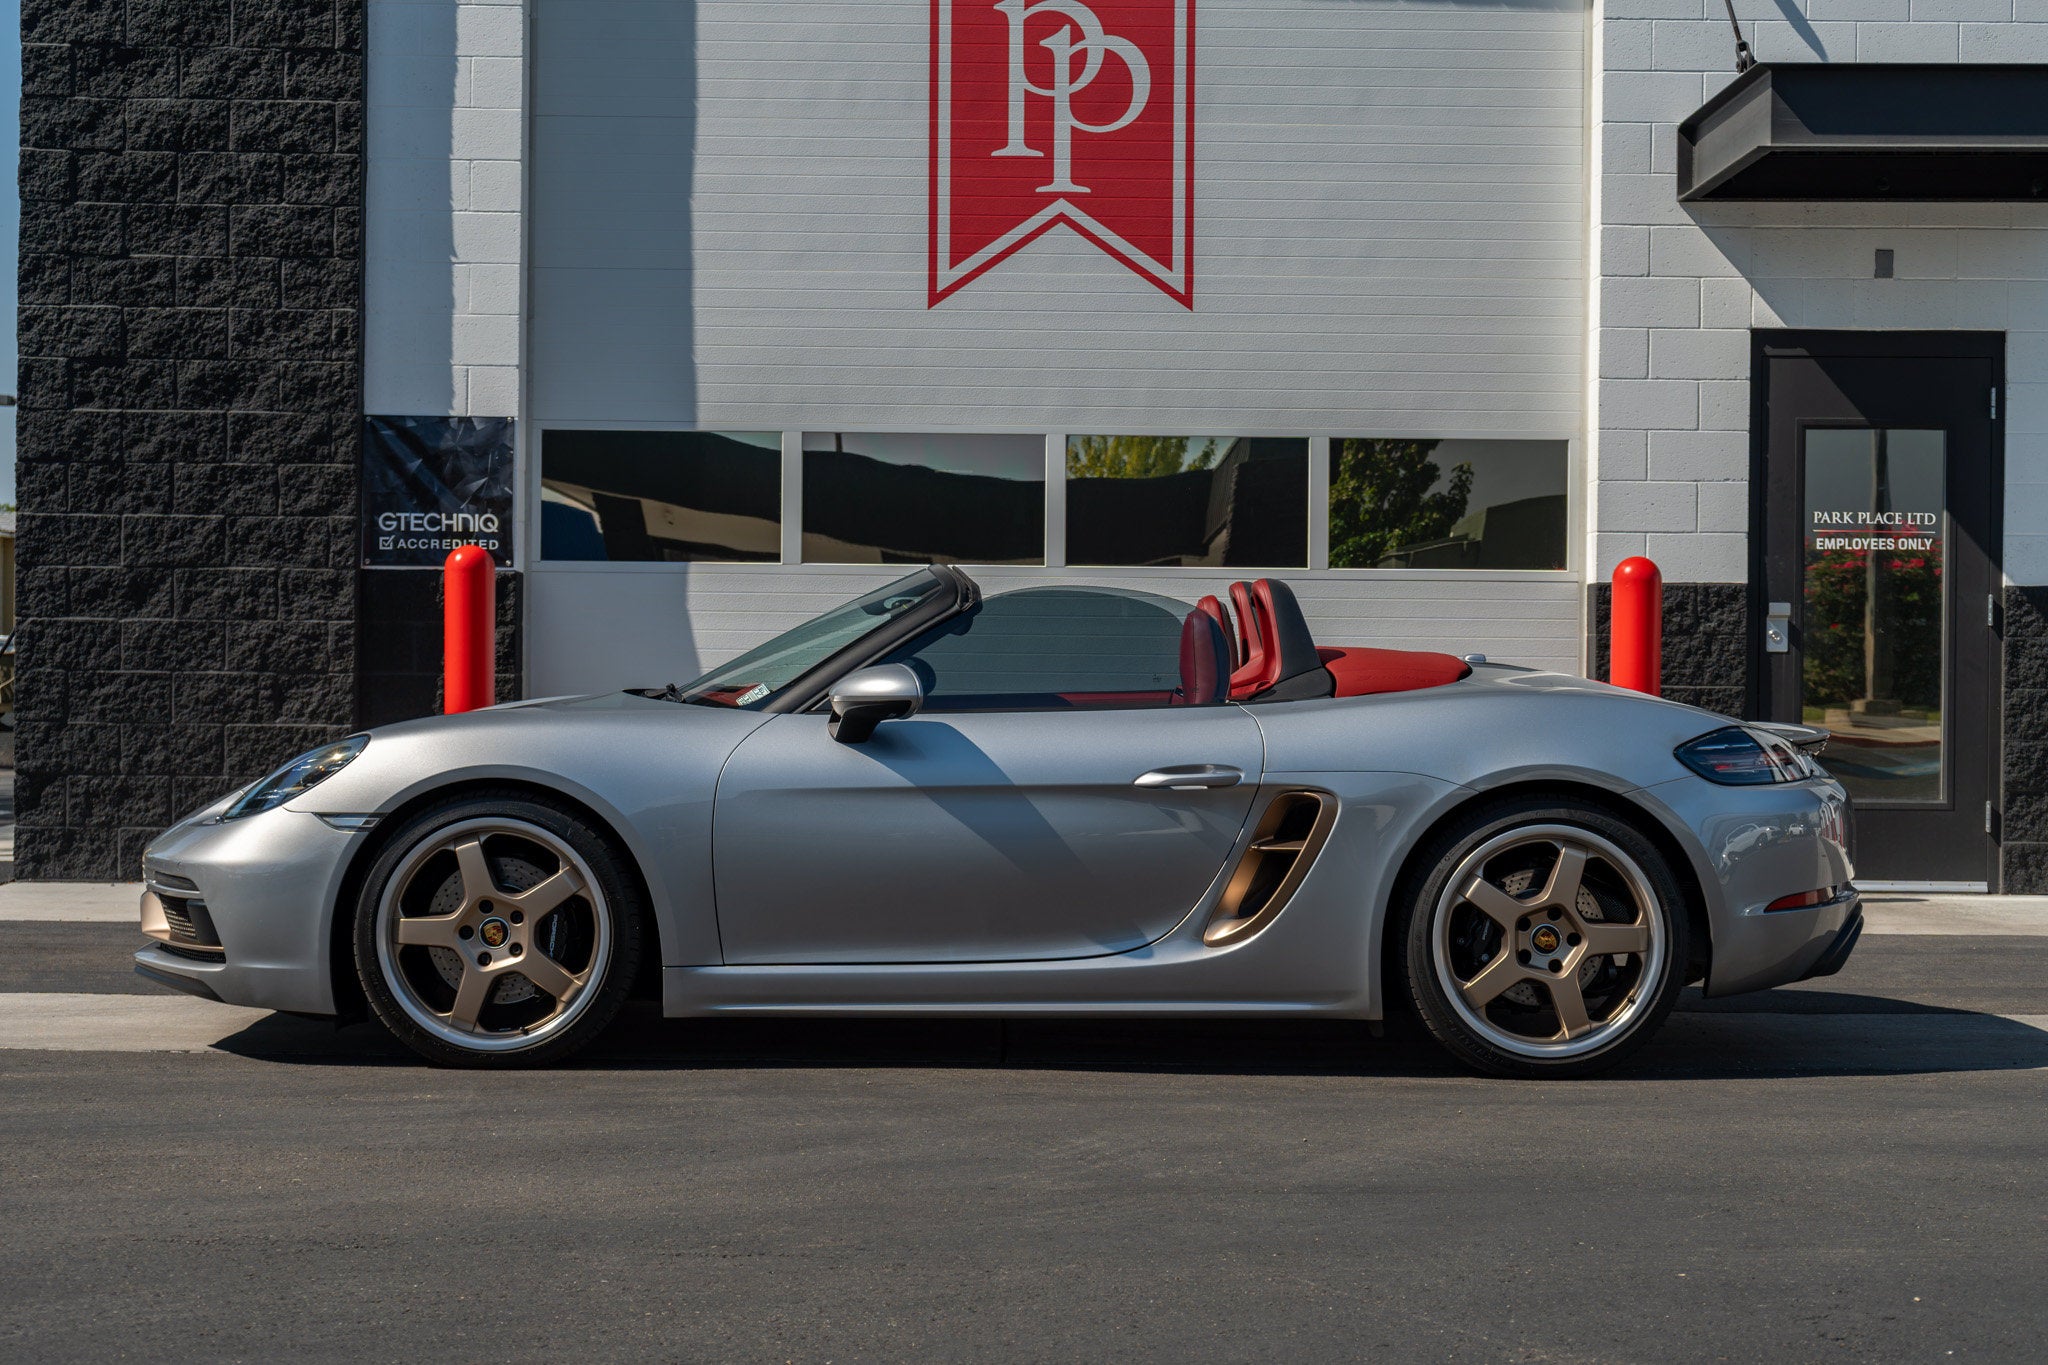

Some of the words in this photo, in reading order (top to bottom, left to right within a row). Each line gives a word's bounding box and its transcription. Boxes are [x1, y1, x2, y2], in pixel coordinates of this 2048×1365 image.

[378, 512, 499, 533] GTECHNIQ
[1813, 511, 1854, 524] PARK
[1857, 511, 1903, 525] PLACE
[1907, 512, 1937, 525] LTD
[1816, 537, 1895, 550] EMPLOYEES
[1898, 538, 1933, 550] ONLY
